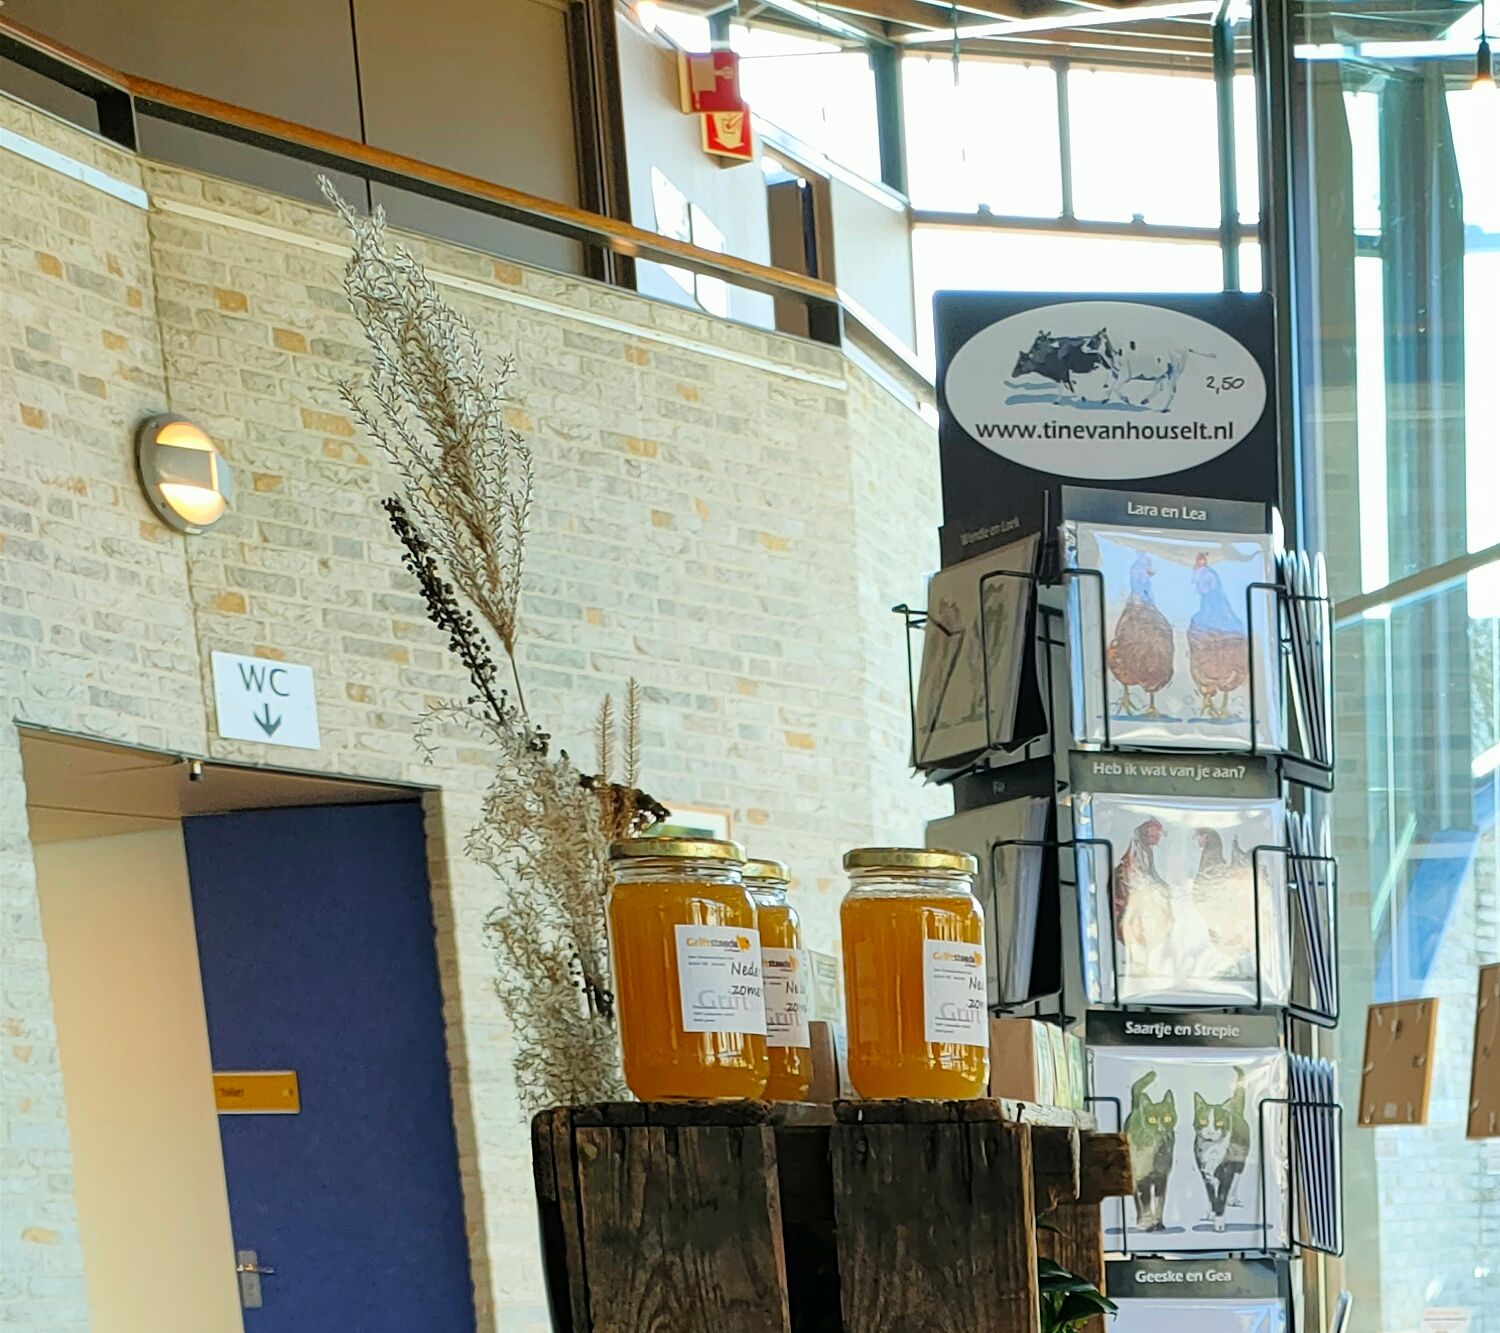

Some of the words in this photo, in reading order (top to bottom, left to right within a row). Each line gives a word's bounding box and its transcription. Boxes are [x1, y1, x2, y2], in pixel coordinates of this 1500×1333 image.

[1206, 375, 1246, 395] 2,50
[975, 420, 1235, 440] www.tinevanhouselt.nl
[1127, 501, 1159, 518] Lara
[1161, 507, 1180, 519] en
[1182, 505, 1207, 520] Lea
[237, 662, 291, 697] WC
[1092, 762, 1122, 776] Heb
[1125, 764, 1137, 777] ik
[1140, 765, 1167, 777] wat
[1169, 767, 1194, 778] van
[1195, 765, 1211, 780] je
[1212, 766, 1246, 779] aan?
[1125, 1020, 1172, 1038] Saartje
[1173, 1024, 1192, 1036] en
[1134, 1269, 1184, 1283] Geeske
[1185, 1271, 1204, 1282] en
[1204, 1269, 1233, 1282] Gea
